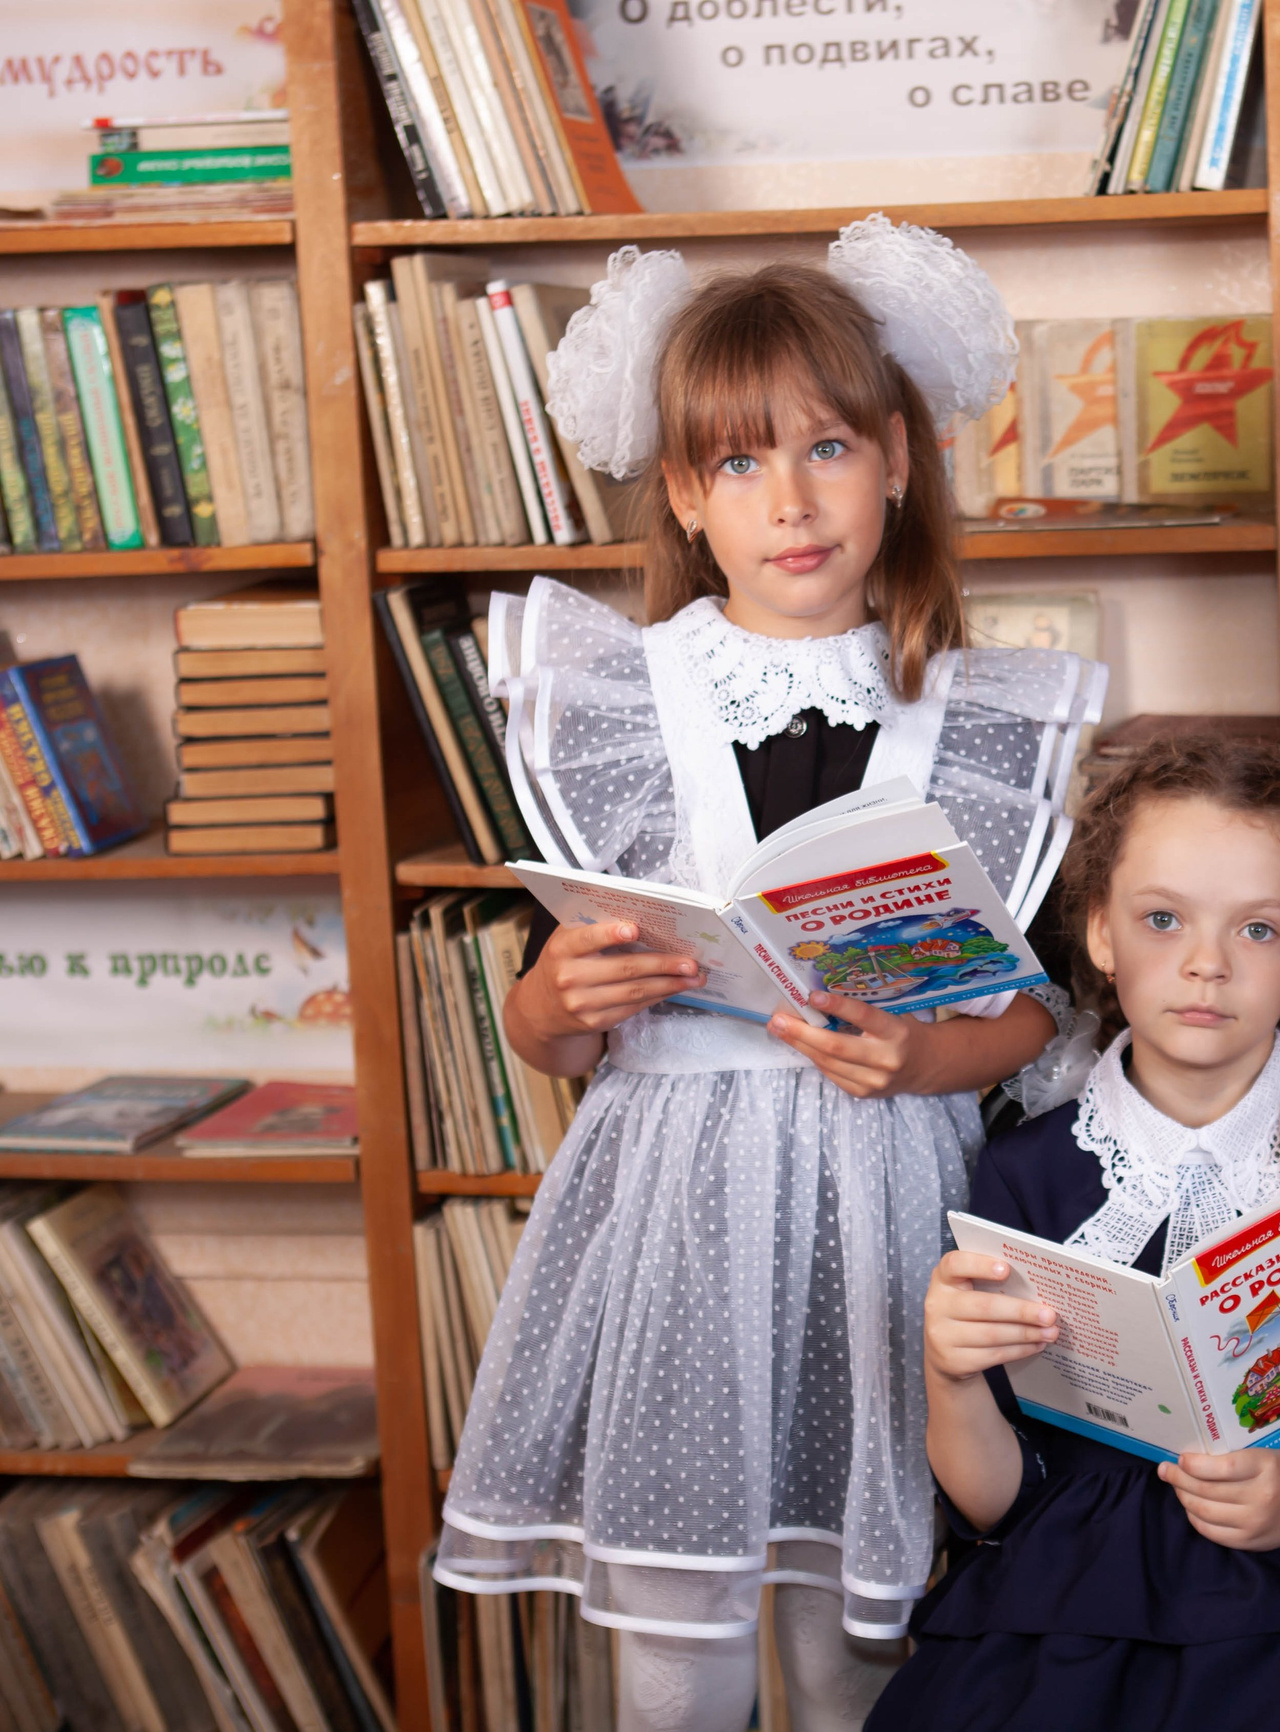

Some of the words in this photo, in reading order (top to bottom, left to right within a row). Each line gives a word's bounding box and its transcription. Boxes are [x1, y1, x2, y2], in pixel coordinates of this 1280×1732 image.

[619, 0, 649, 25] О
[720, 45, 745, 69] о
[764, 32, 997, 70] подвигах,
[0, 45, 225, 98] мудрость
[907, 82, 932, 109] о
[951, 75, 1090, 108] славе
[783, 883, 850, 904] Школьная
[855, 863, 932, 887] библиотека
[785, 900, 853, 922] ПЕСНИ
[859, 895, 875, 903] И
[881, 877, 953, 900] СТИХИ
[800, 920, 825, 933] О
[831, 890, 952, 926] РОДИНЕ
[67, 953, 90, 976] к
[752, 942, 772, 964] ПЕСНИ
[766, 960, 775, 968] И
[770, 964, 789, 985] СТИХИ
[783, 980, 793, 990] О
[786, 984, 809, 1010] РОДИНЕ
[1001, 1244, 1037, 1259] Авторы
[1211, 1230, 1274, 1268] Школьная
[1001, 1251, 1062, 1275] включенных
[1073, 1277, 1117, 1295] сборник:
[1219, 1294, 1240, 1314] О
[1180, 1336, 1199, 1373] РАССКАЗЫ
[1193, 1380, 1208, 1403] СТИХИ
[1201, 1404, 1211, 1412] О
[1203, 1412, 1221, 1441] РОДИНЕ
